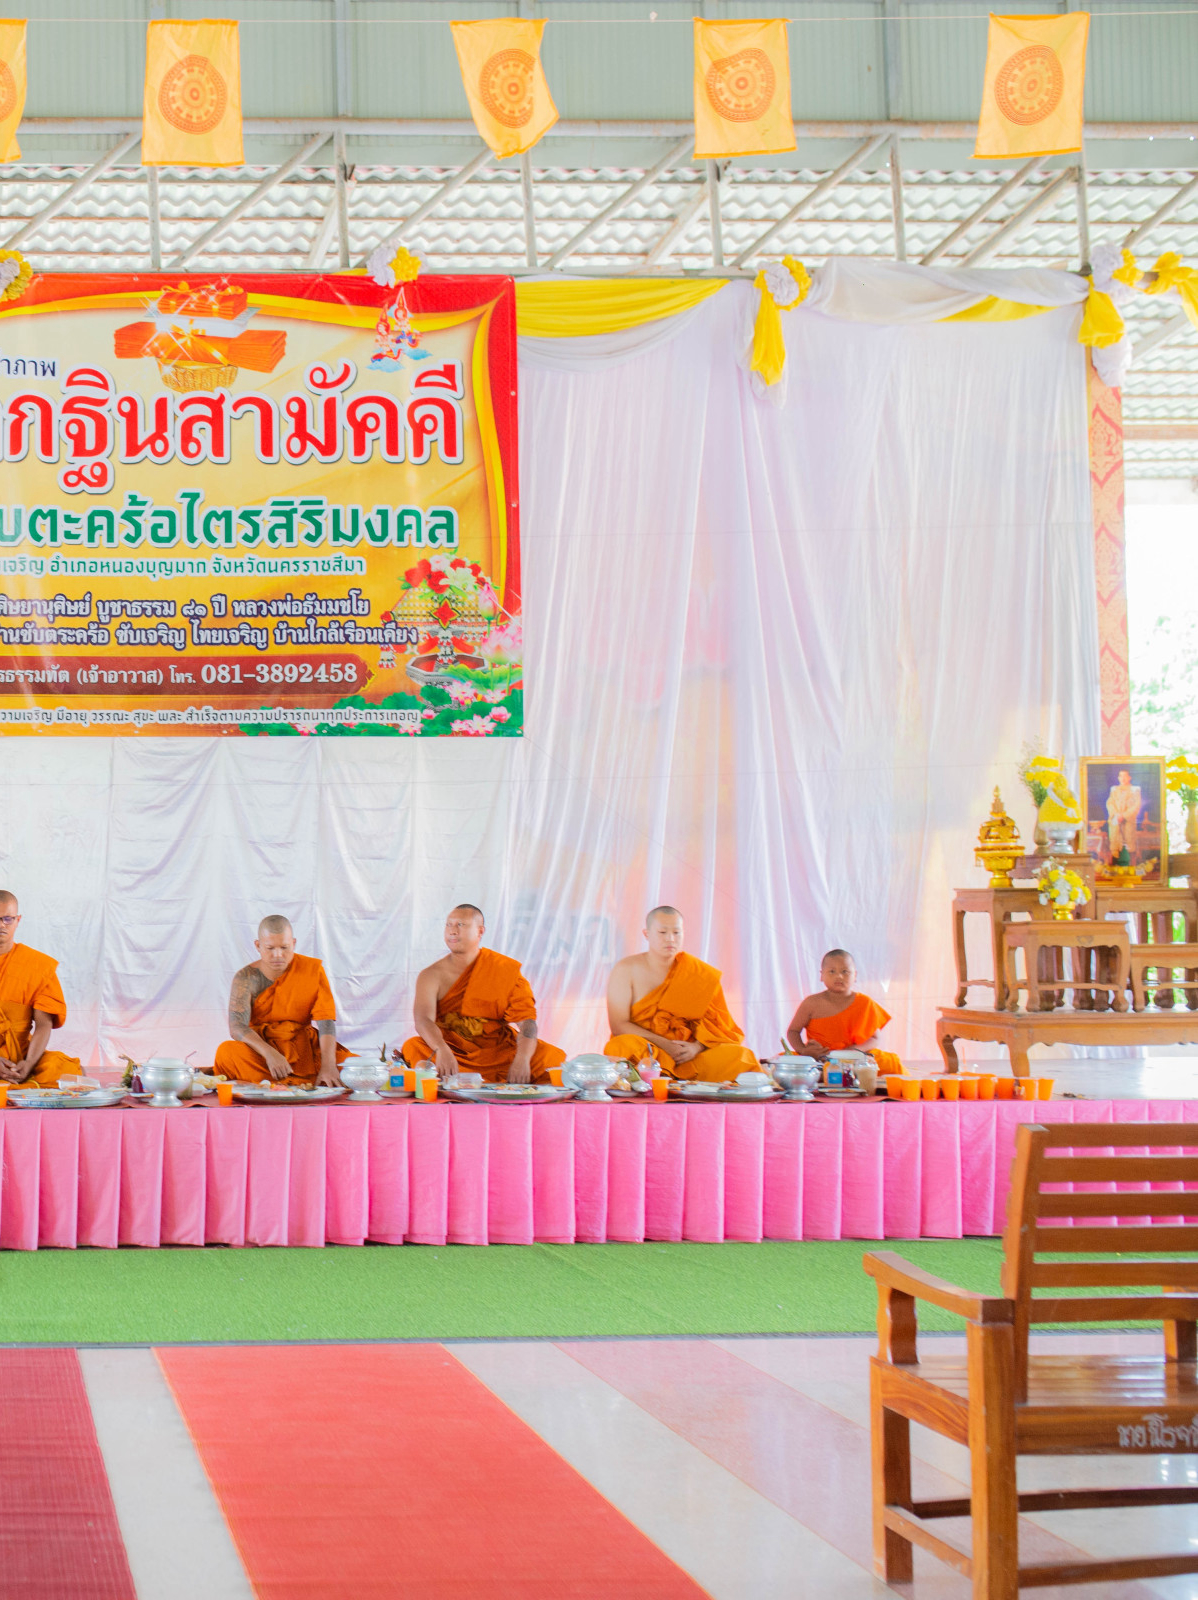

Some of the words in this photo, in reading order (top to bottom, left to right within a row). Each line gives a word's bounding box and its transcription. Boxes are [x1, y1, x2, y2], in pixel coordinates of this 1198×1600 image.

[50, 555, 206, 578] อำเภอหนองบุญมาก
[212, 556, 363, 573] จังหวัดนครราชสีมา
[97, 600, 175, 622] บูชาธรรม
[211, 594, 227, 616] ปี
[232, 589, 370, 616] หลวงพ่อธัมมชโย
[115, 622, 185, 649] ซับเจริญ
[191, 618, 268, 649] ไทยเจริญ
[274, 618, 418, 644] บ้านใกล้เรือนเคียง
[76, 665, 163, 685] (เจ้าอาวาส)
[170, 665, 196, 684] โทร.
[201, 663, 358, 684] 081-3892458
[57, 707, 87, 726] มีอายุ
[91, 710, 129, 721] วรรณะ
